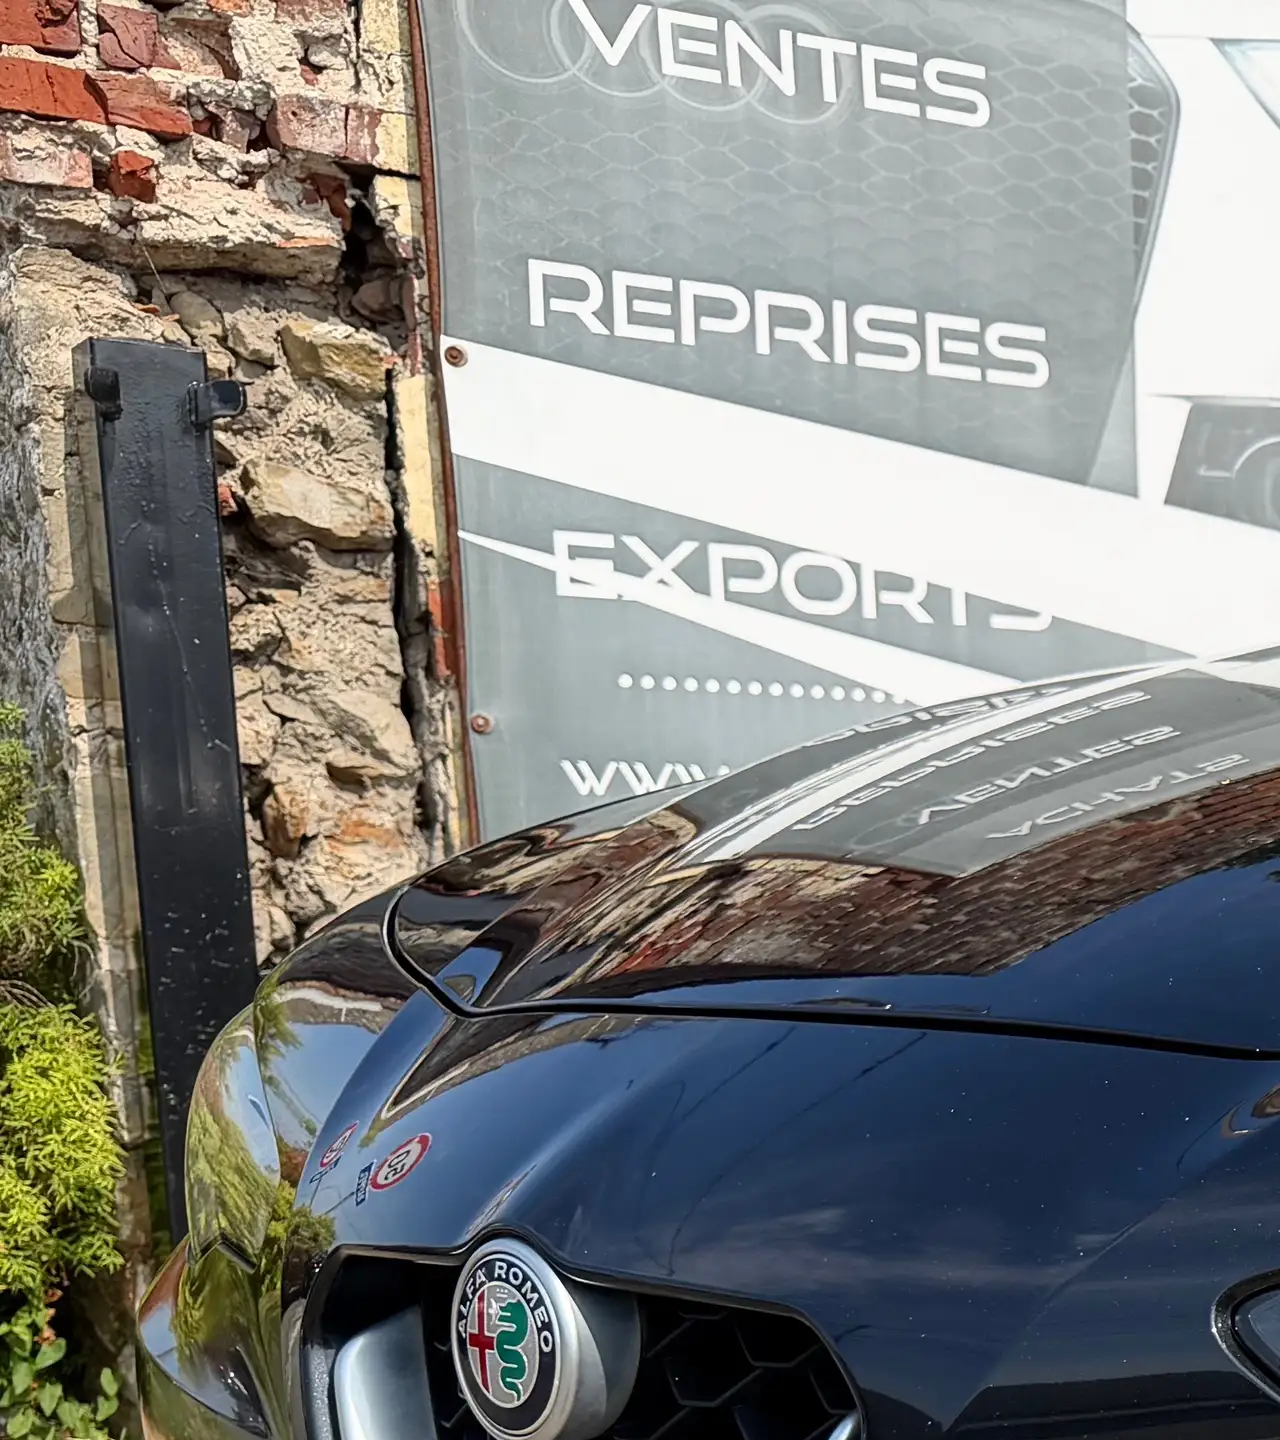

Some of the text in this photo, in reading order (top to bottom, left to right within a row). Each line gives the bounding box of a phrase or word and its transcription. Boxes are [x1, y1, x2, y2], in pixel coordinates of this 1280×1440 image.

[567, 0, 991, 129] VENTES
[527, 257, 1051, 389] REPRISES
[457, 1260, 554, 1354] ALFA ROMEO
